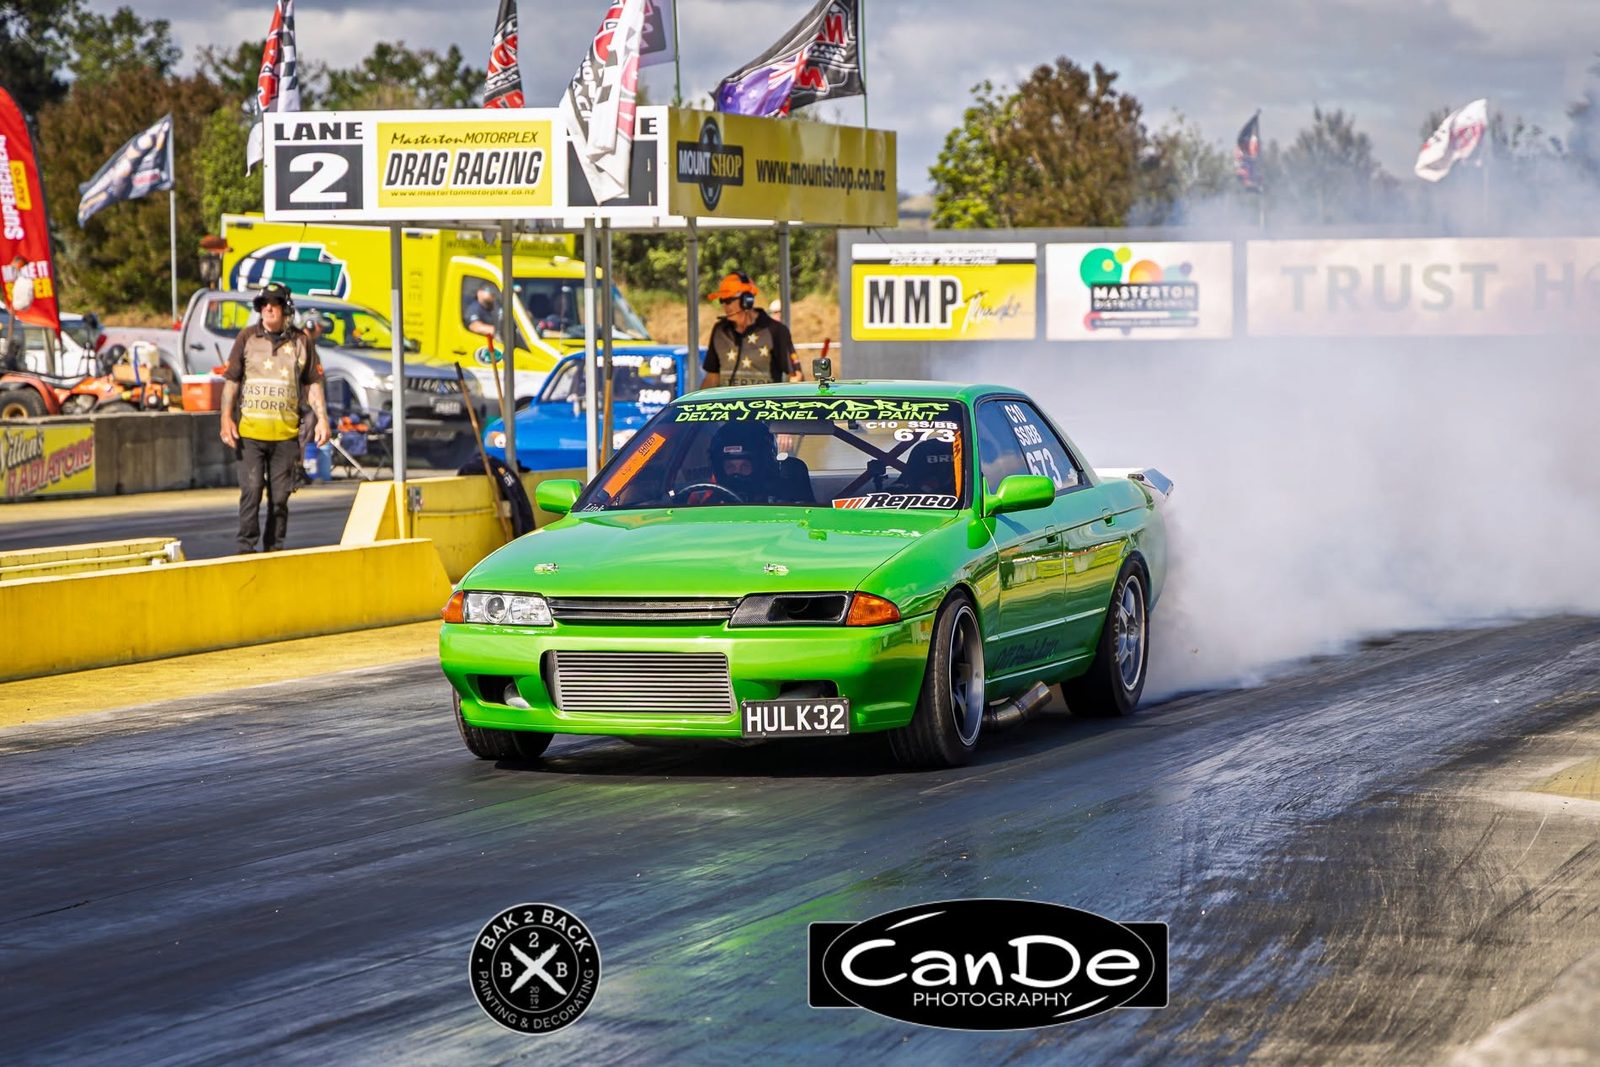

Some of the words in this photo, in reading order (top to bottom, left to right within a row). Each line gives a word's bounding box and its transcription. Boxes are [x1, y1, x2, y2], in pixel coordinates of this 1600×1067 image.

[274, 122, 363, 141] LANE
[289, 152, 349, 203] 2
[385, 152, 448, 186] DRAG
[452, 150, 543, 185] RACING
[678, 149, 711, 176] MOUNT
[711, 153, 742, 179] SHOP
[756, 158, 886, 196] www.mountshop.co.nz
[868, 280, 957, 324] MMP
[1093, 285, 1195, 300] MASTERTON
[1281, 263, 1498, 313] TRUST
[675, 412, 729, 421] DELTA
[736, 411, 751, 420] J
[755, 411, 819, 420] PANEL
[825, 411, 869, 420] AND
[878, 411, 939, 420] PAINT
[866, 421, 898, 429] C10
[908, 421, 958, 430] SS/BB
[1004, 404, 1027, 424] C10
[893, 428, 956, 442] 673
[7, 434, 96, 497] RADIATORS
[1026, 448, 1063, 488] 673
[866, 493, 958, 509] Repco
[746, 704, 845, 732] HULK32
